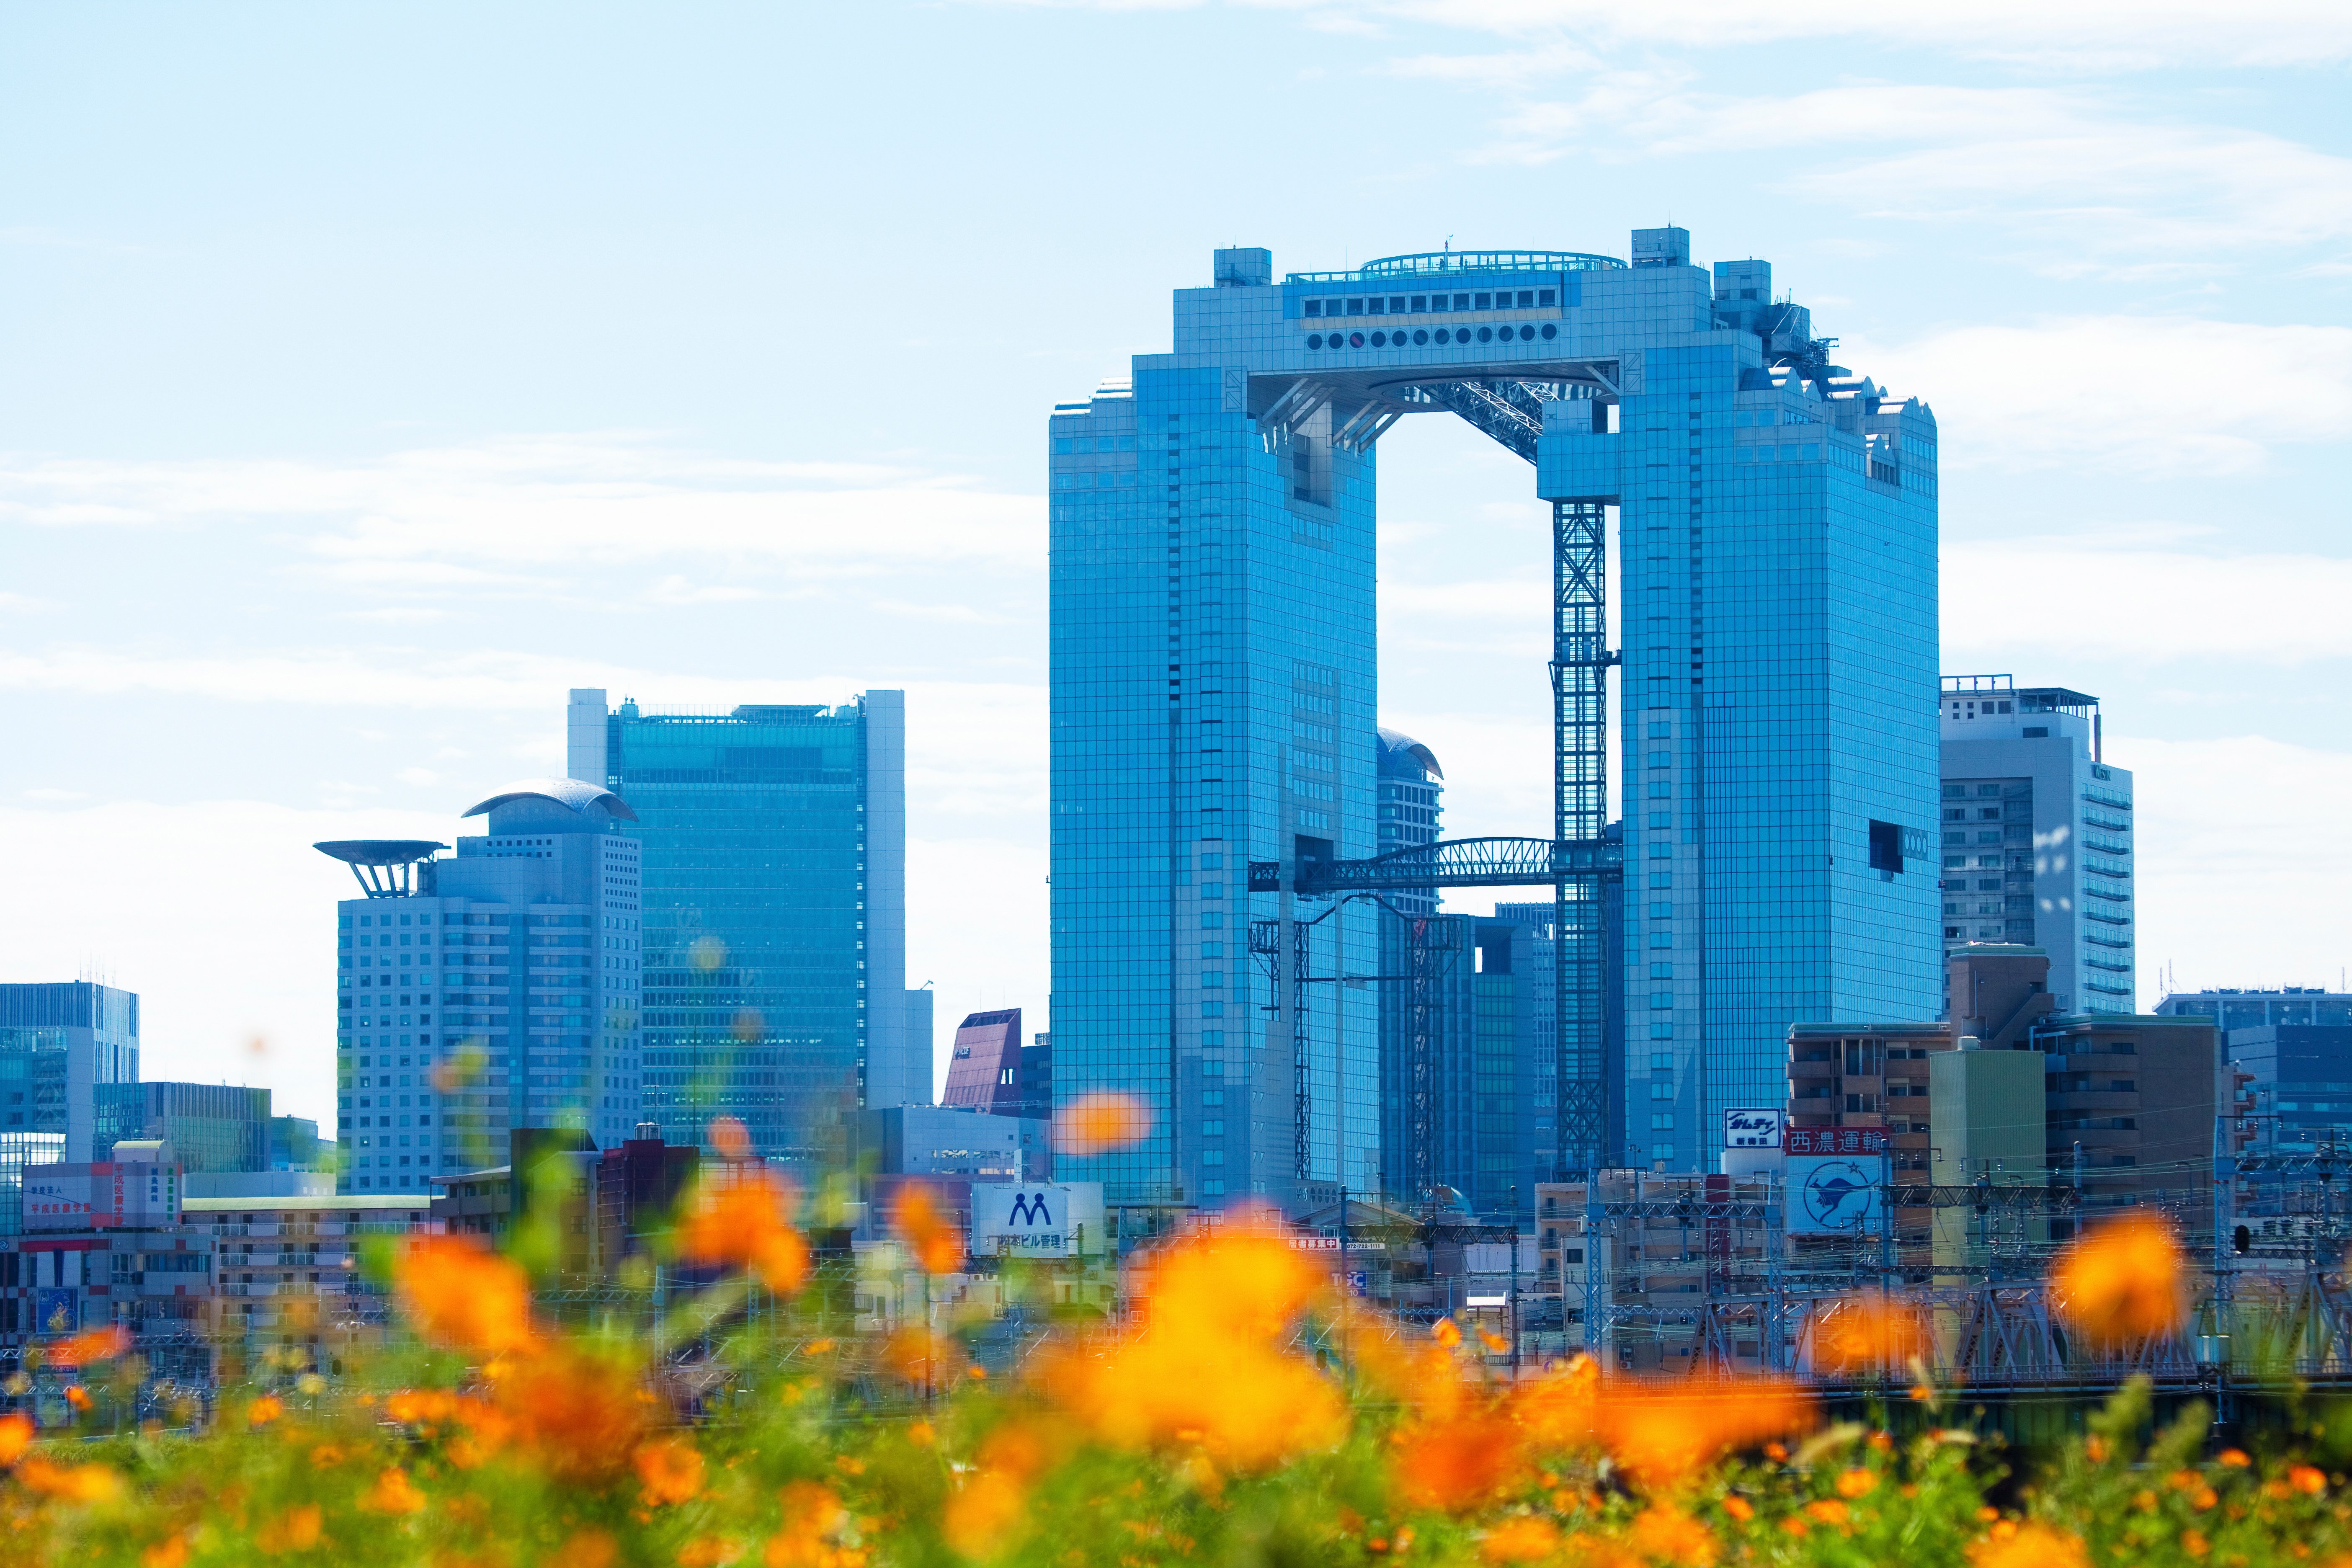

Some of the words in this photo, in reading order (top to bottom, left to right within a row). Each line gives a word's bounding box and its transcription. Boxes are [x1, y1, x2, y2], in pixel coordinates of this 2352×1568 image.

[1730, 1119, 1774, 1130] サムティ
[1790, 1131, 1884, 1153] 西濃運輸
